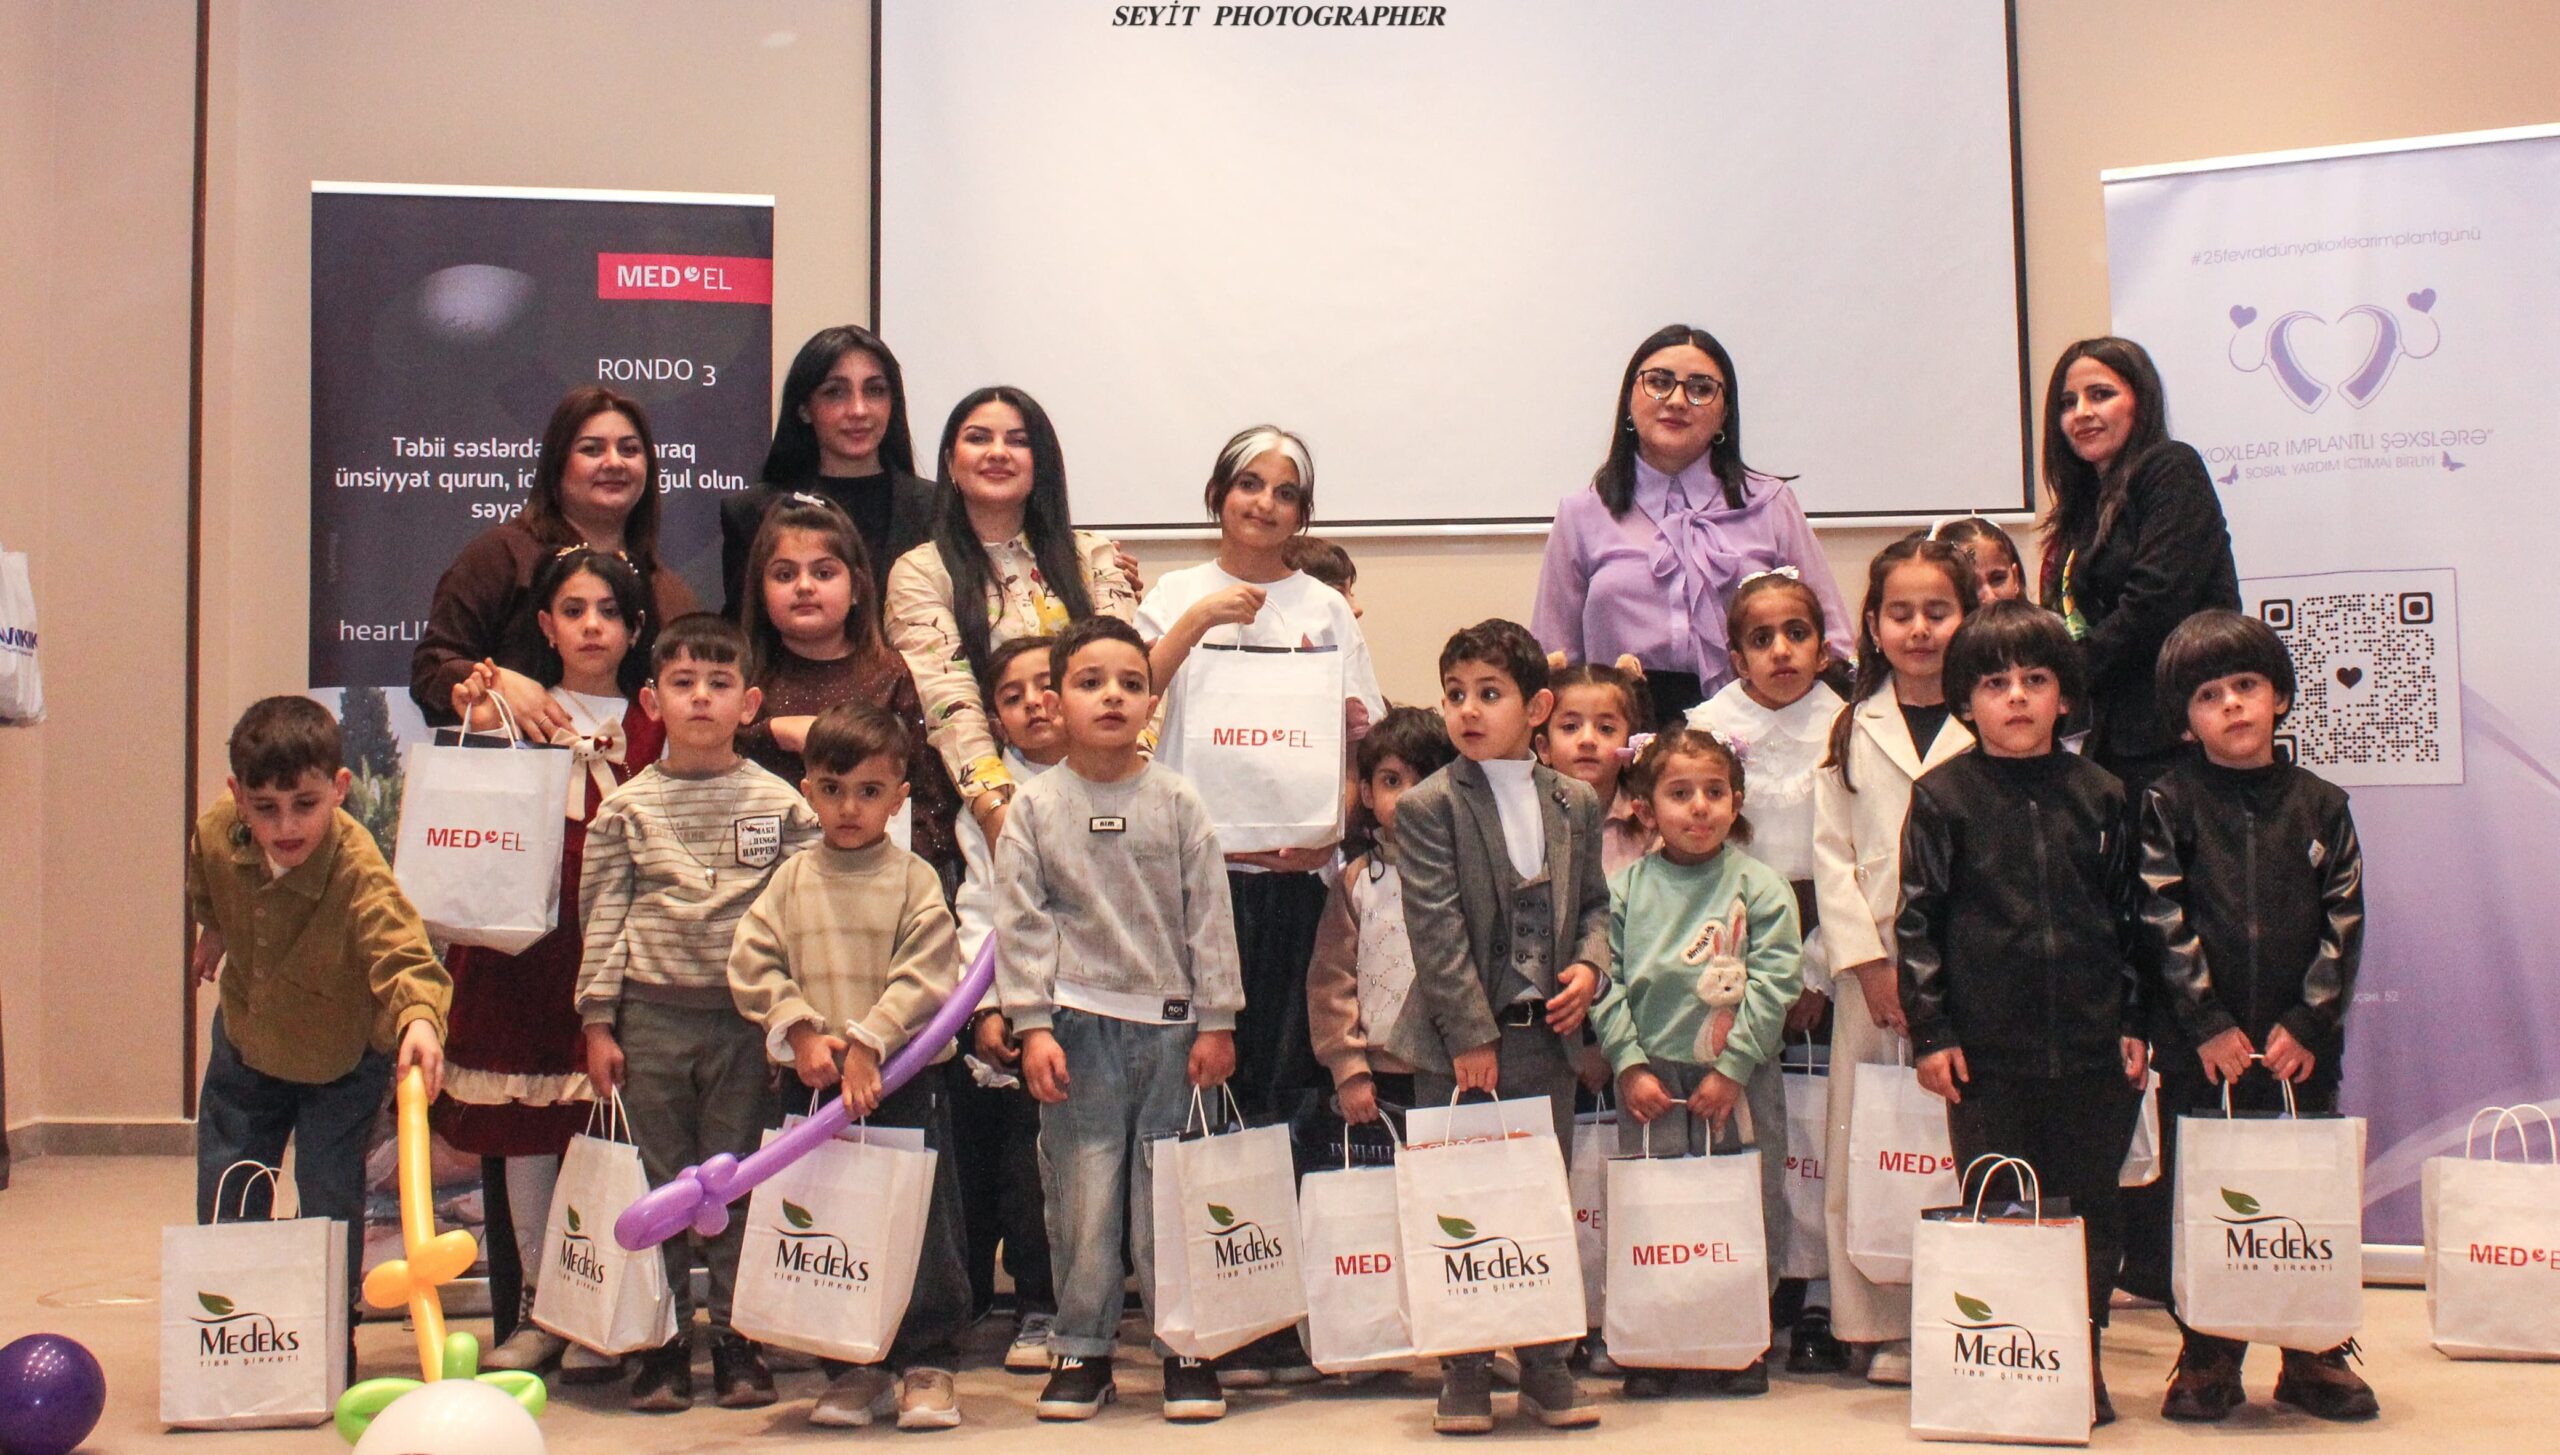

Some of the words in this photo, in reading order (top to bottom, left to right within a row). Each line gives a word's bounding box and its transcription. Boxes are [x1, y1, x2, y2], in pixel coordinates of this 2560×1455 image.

[617, 265, 681, 288] MED
[703, 267, 733, 290] EL
[598, 359, 693, 381] RONDO
[702, 365, 717, 387] 3
[392, 436, 446, 457] Təbii
[453, 437, 543, 458] səslərdə
[335, 468, 430, 493] ünsiyyət
[438, 471, 510, 493] qurun,
[658, 468, 692, 494] ğul
[698, 469, 750, 490] olun.
[471, 498, 528, 524] səya
[340, 619, 429, 642] hearLI
[1213, 728, 1268, 746] MED
[1289, 730, 1314, 748] EL
[427, 828, 481, 848] MED
[502, 832, 526, 851] EL
[1879, 1150, 1936, 1175] MED
[1335, 1253, 1392, 1276] MED
[1632, 1244, 1690, 1266] MED
[1712, 1242, 1738, 1263] EL
[2470, 1244, 2528, 1266] MED
